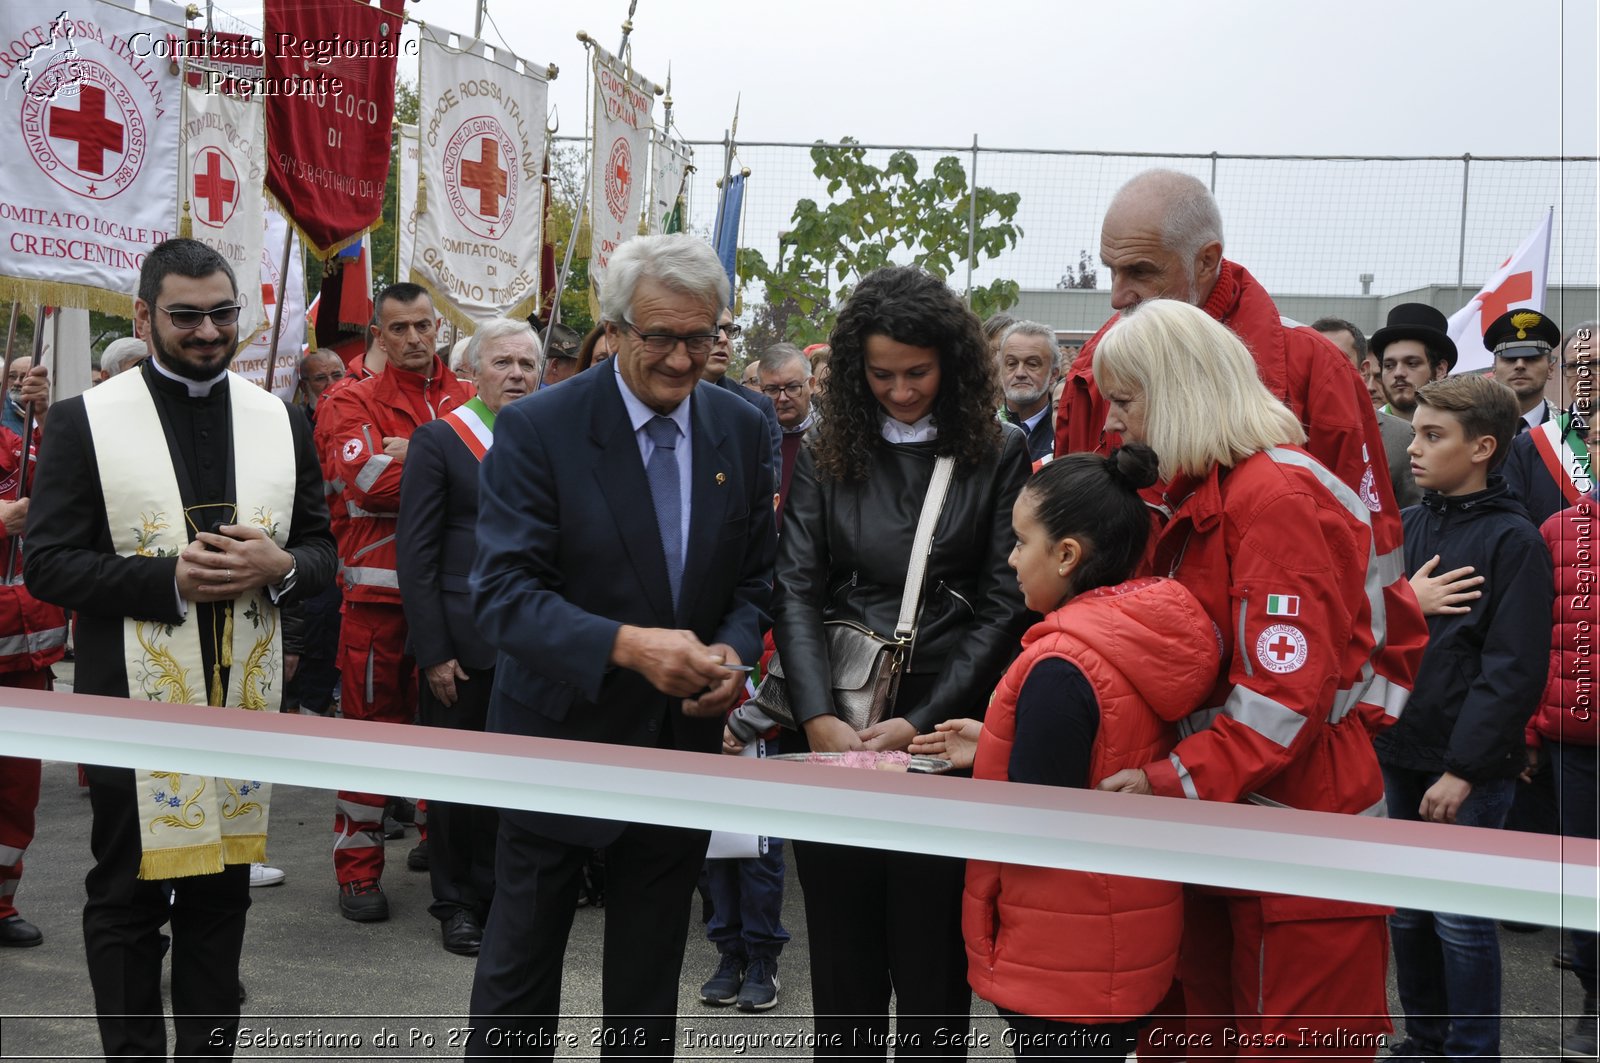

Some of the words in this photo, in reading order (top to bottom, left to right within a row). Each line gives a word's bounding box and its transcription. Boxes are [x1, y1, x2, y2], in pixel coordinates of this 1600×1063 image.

[108, 35, 165, 120] ITALIANA
[117, 90, 131, 106] 22
[459, 80, 502, 103] ROSSA
[335, 91, 377, 124] LOCO
[126, 108, 142, 165] AGOSTO
[328, 127, 341, 149] DI
[114, 166, 134, 188] 1864
[0, 203, 90, 231] OMITATO
[94, 218, 147, 243] LOCALE
[442, 236, 498, 258] COMITATO
[423, 248, 484, 302] GASSINO
[487, 265, 497, 276] DI
